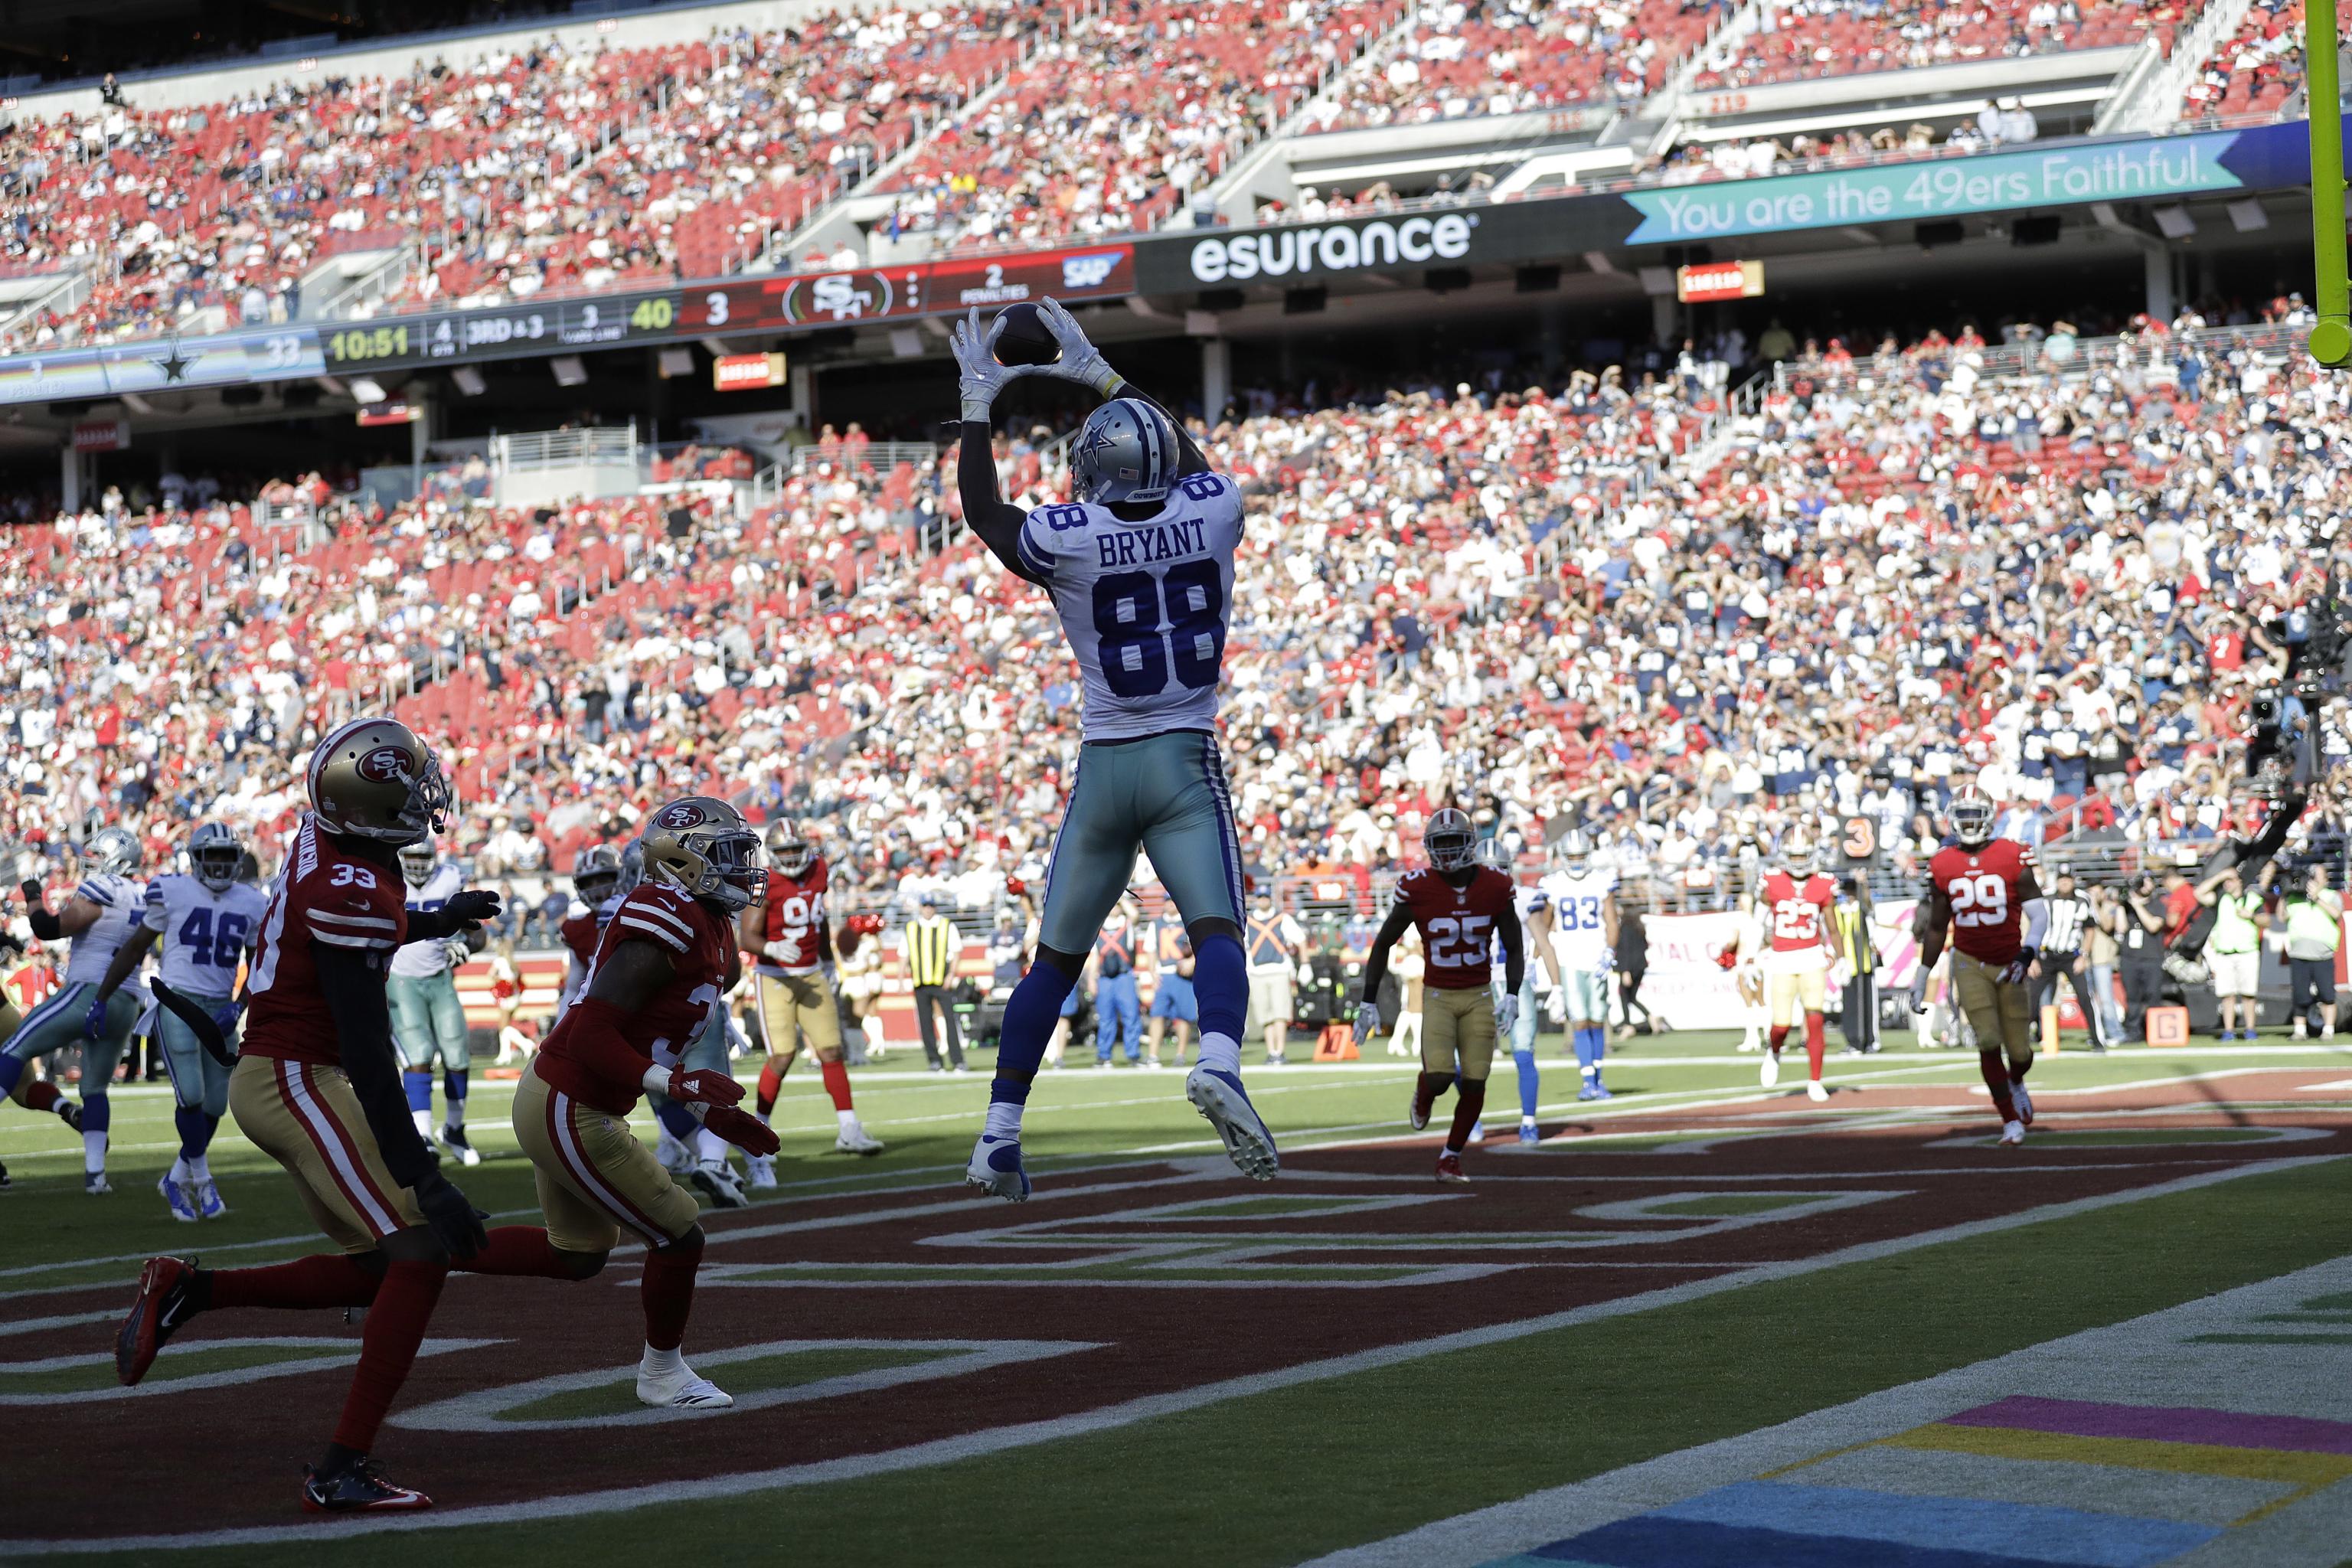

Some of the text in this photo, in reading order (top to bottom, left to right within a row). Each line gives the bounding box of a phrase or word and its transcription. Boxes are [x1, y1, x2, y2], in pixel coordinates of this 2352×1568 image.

[1658, 141, 2208, 236] You are the 49ers Faithful.
[1191, 214, 1471, 283] esurance
[985, 263, 1004, 287] 2
[1063, 258, 1112, 289] SAP
[581, 304, 599, 329] 3
[630, 298, 672, 329] 40
[705, 292, 729, 325] 3
[329, 325, 408, 361] 10:51
[434, 318, 452, 342] 4
[528, 314, 544, 339] 3
[1096, 518, 1206, 568] BRYANT
[1093, 558, 1224, 698] 88
[668, 807, 697, 827] SF
[1843, 818, 1875, 858] 3
[330, 864, 377, 889] 33
[782, 893, 825, 939] 94
[1560, 896, 1599, 930] 83
[1948, 874, 2007, 927] 29
[1775, 899, 1819, 939] 23
[178, 906, 249, 967] 46
[1159, 927, 1184, 960] K
[1427, 915, 1491, 968] 25
[2157, 1014, 2177, 1039] G
